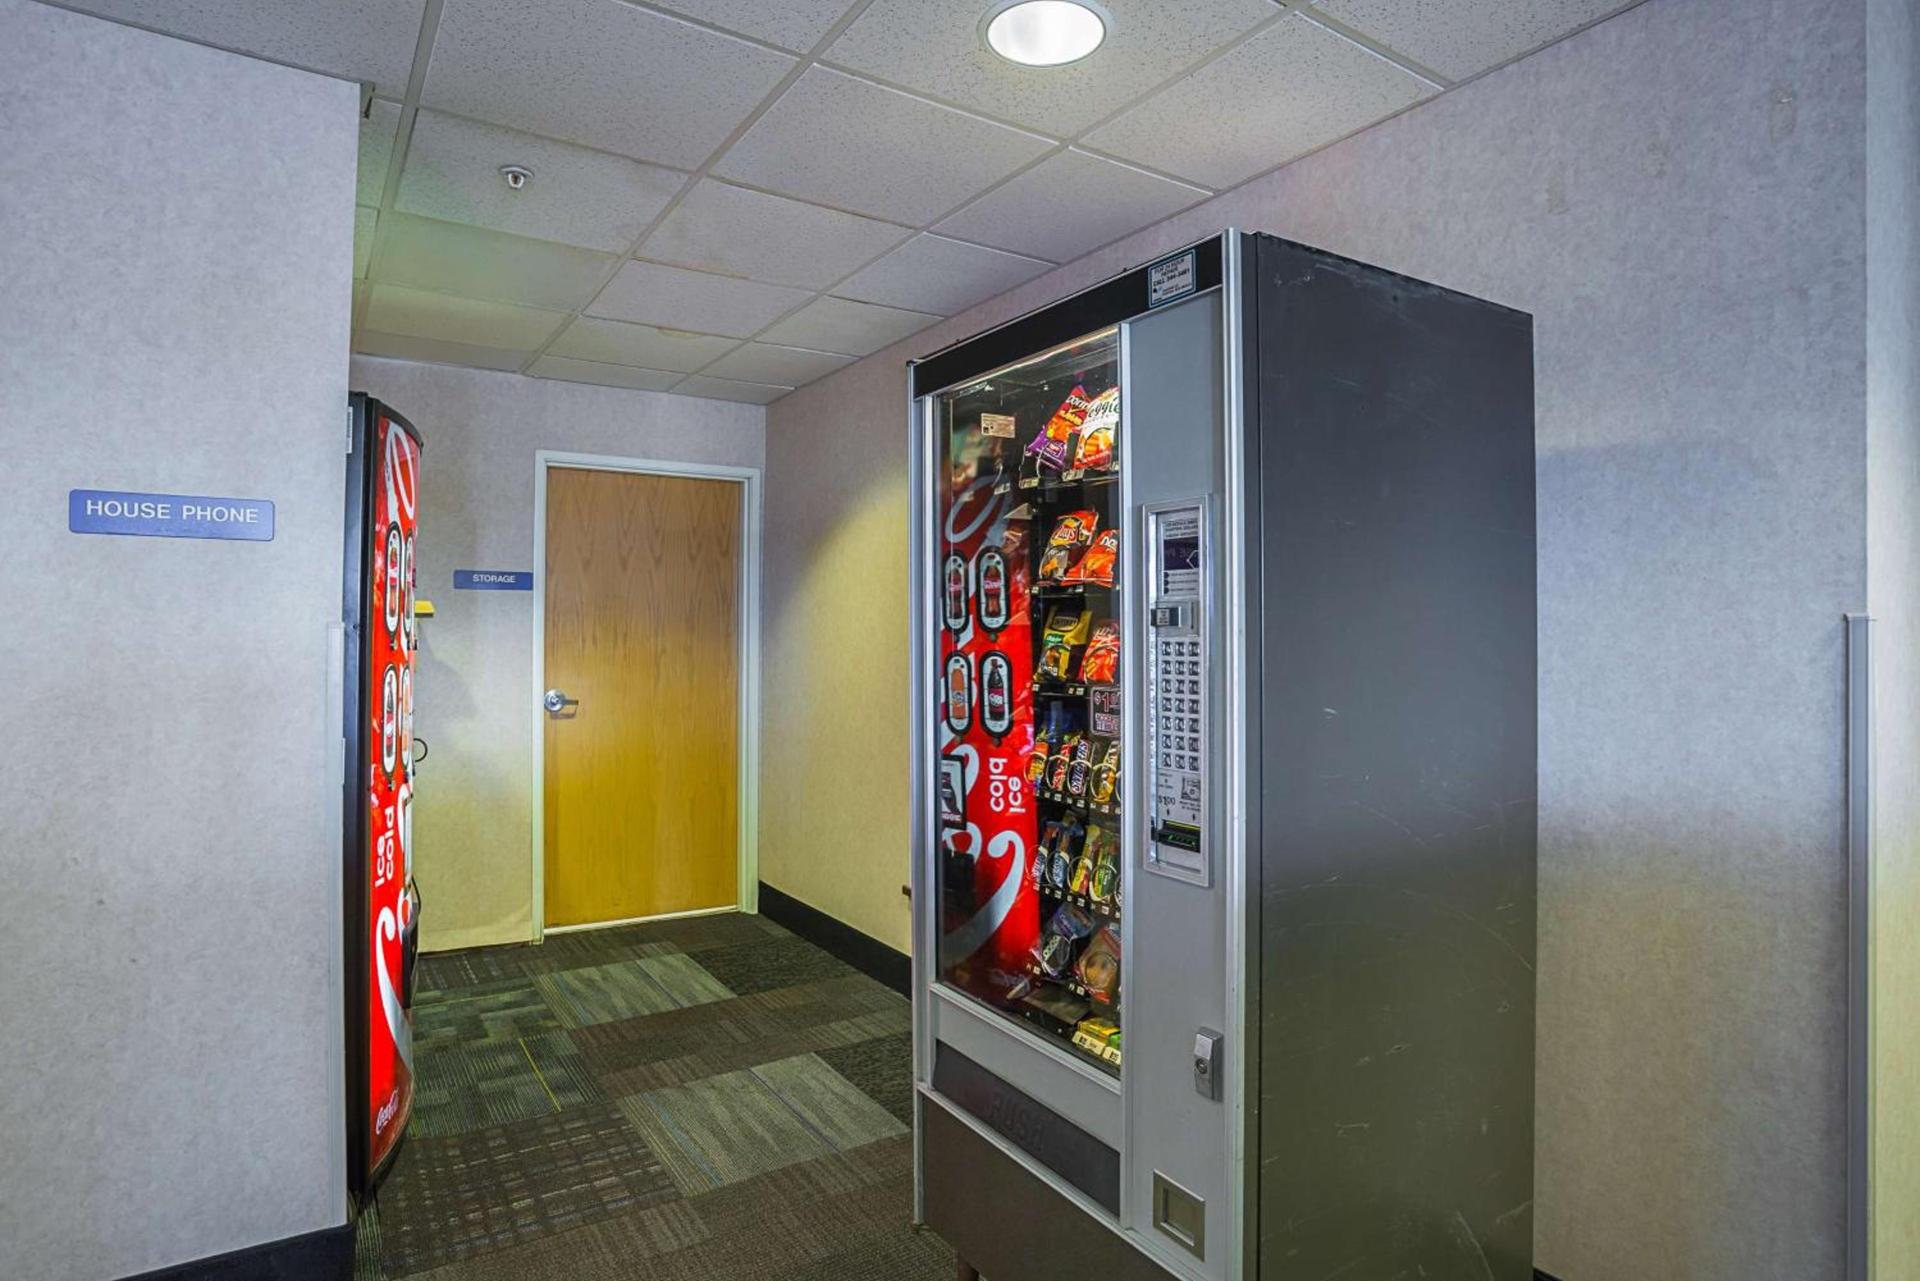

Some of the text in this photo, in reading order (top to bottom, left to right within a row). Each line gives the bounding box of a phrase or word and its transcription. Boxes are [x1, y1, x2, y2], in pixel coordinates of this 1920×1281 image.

[86, 500, 259, 523] HOUSE PHONE
[472, 574, 517, 583] STORAGE
[374, 835, 385, 888] Ice
[384, 805, 394, 881] cold
